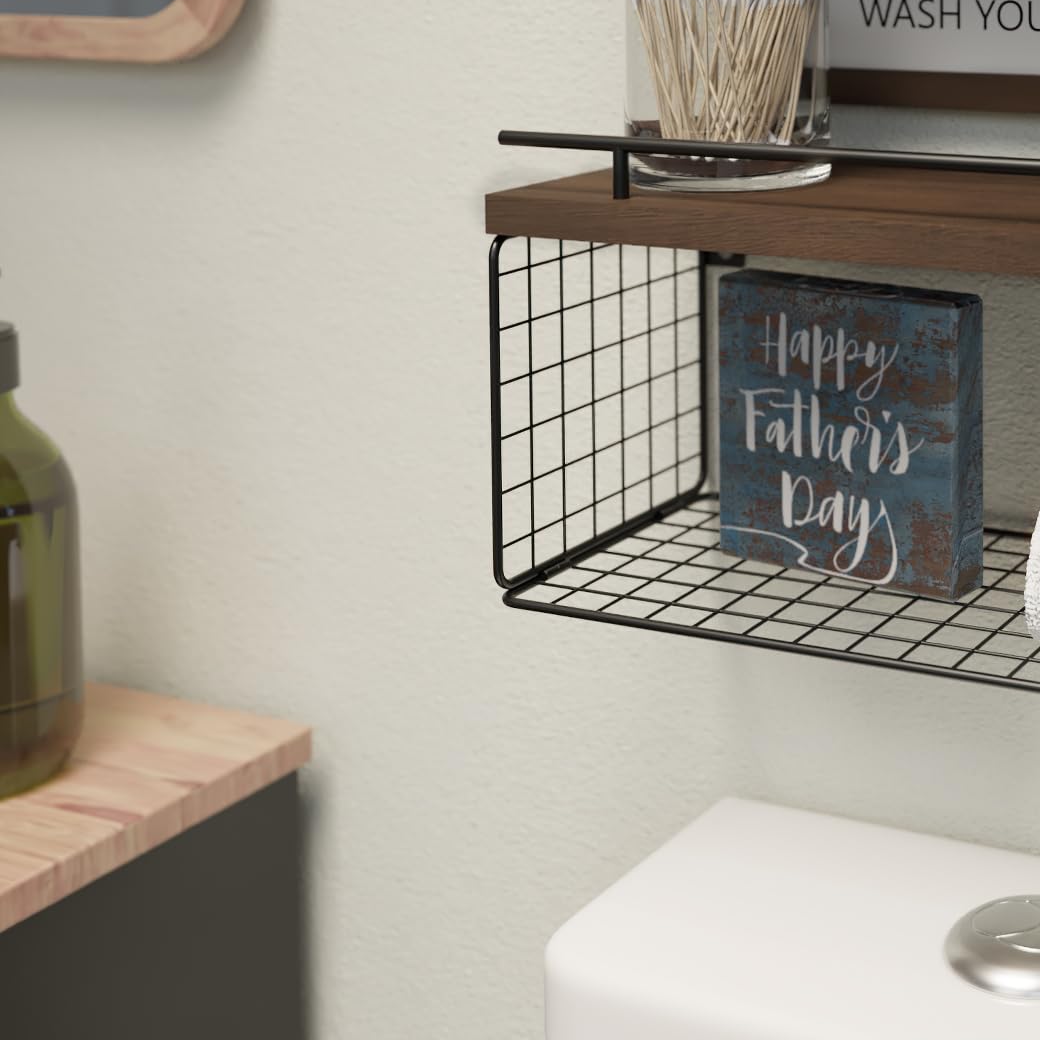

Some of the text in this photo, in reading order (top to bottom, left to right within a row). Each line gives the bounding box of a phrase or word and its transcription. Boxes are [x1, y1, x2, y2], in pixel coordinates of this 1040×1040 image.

[759, 312, 899, 402] Happy
[739, 388, 925, 475] Father's
[780, 470, 898, 580] Day
